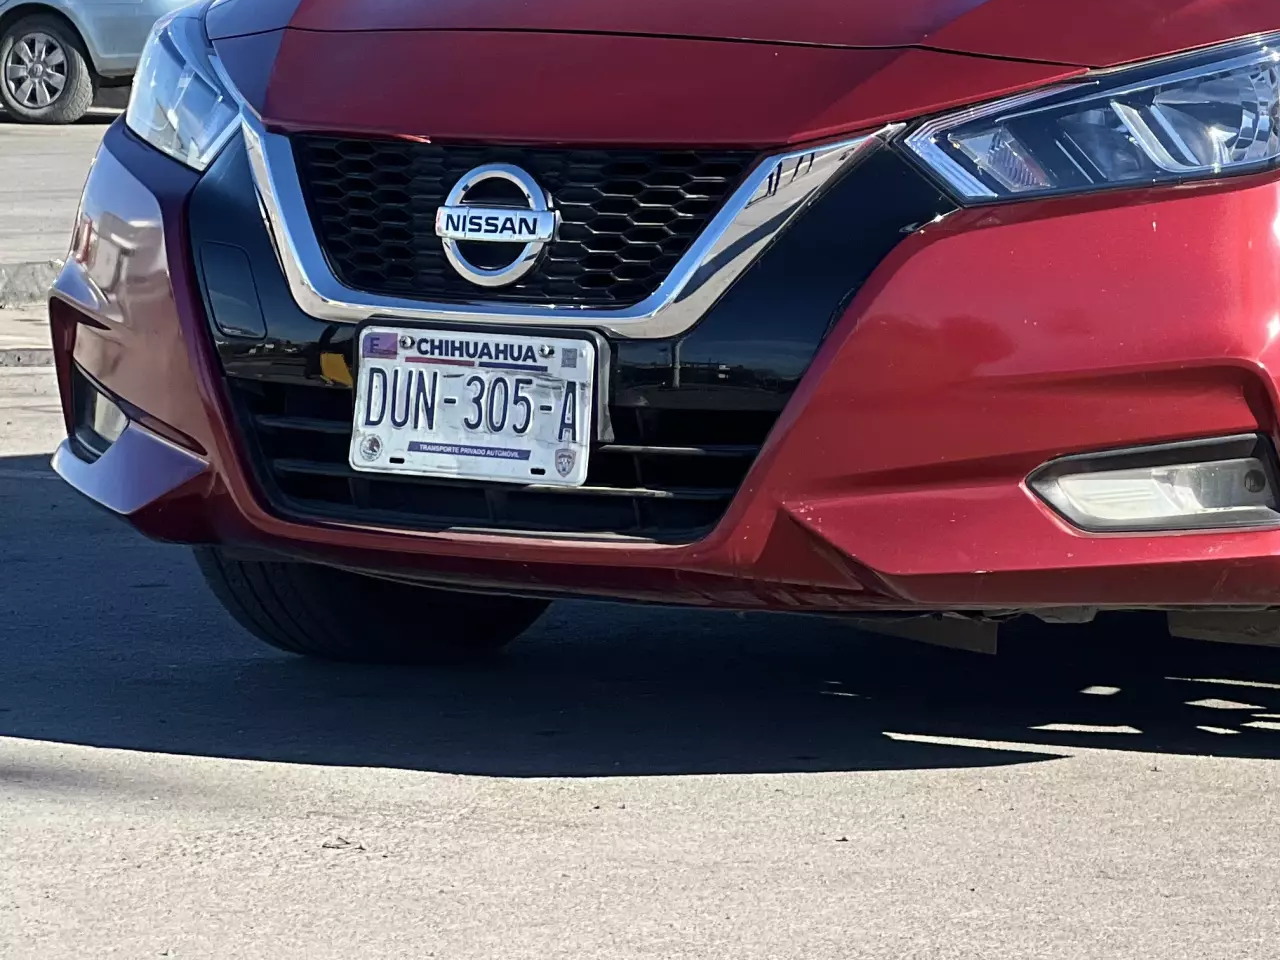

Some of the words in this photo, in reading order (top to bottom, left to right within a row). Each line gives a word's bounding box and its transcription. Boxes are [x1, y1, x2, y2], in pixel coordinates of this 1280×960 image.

[445, 213, 538, 235] NISSAN
[416, 337, 538, 363] CHIHUAHUA
[364, 367, 578, 442] DUN-305-A
[420, 443, 460, 453] TRANSPORTE
[460, 446, 486, 456] PRIVADO
